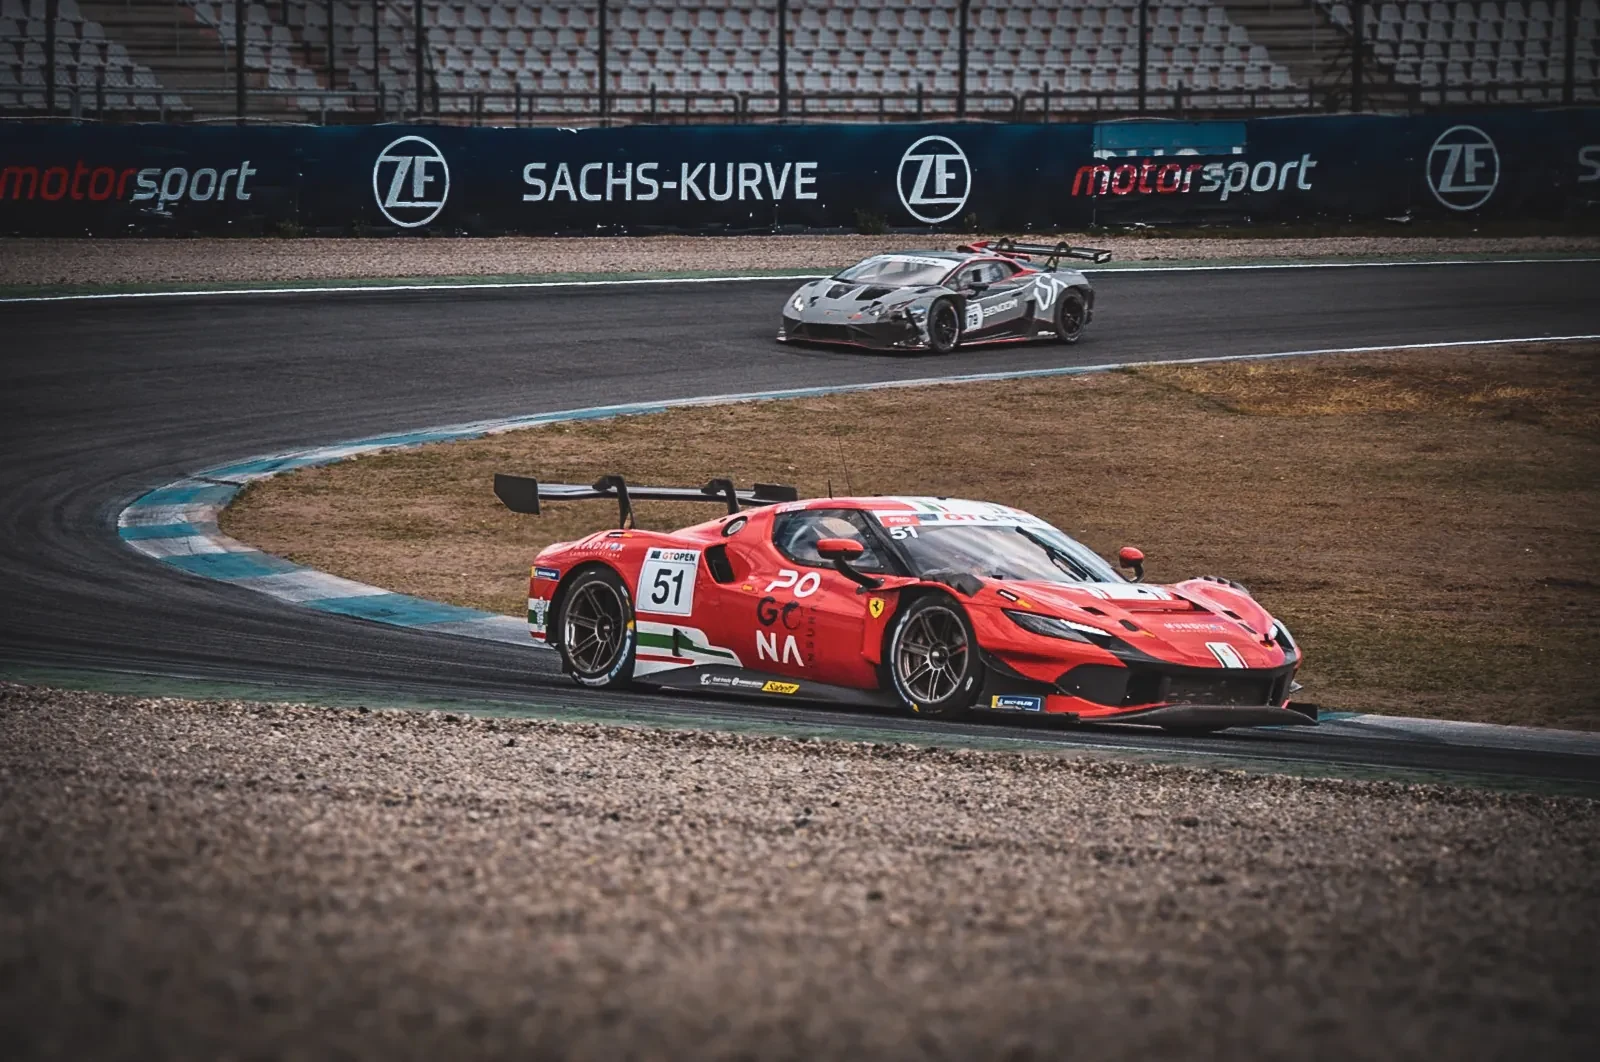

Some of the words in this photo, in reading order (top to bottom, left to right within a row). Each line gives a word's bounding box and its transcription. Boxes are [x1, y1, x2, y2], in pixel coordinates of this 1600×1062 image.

[0, 160, 257, 214] motorsport
[379, 155, 444, 208] ZF
[522, 161, 819, 202] SACHS-KURVE
[903, 154, 968, 204] ZF
[1071, 153, 1319, 201] motorsport
[1433, 143, 1495, 192] ZF
[889, 526, 919, 540] 51
[651, 568, 685, 606] 51
